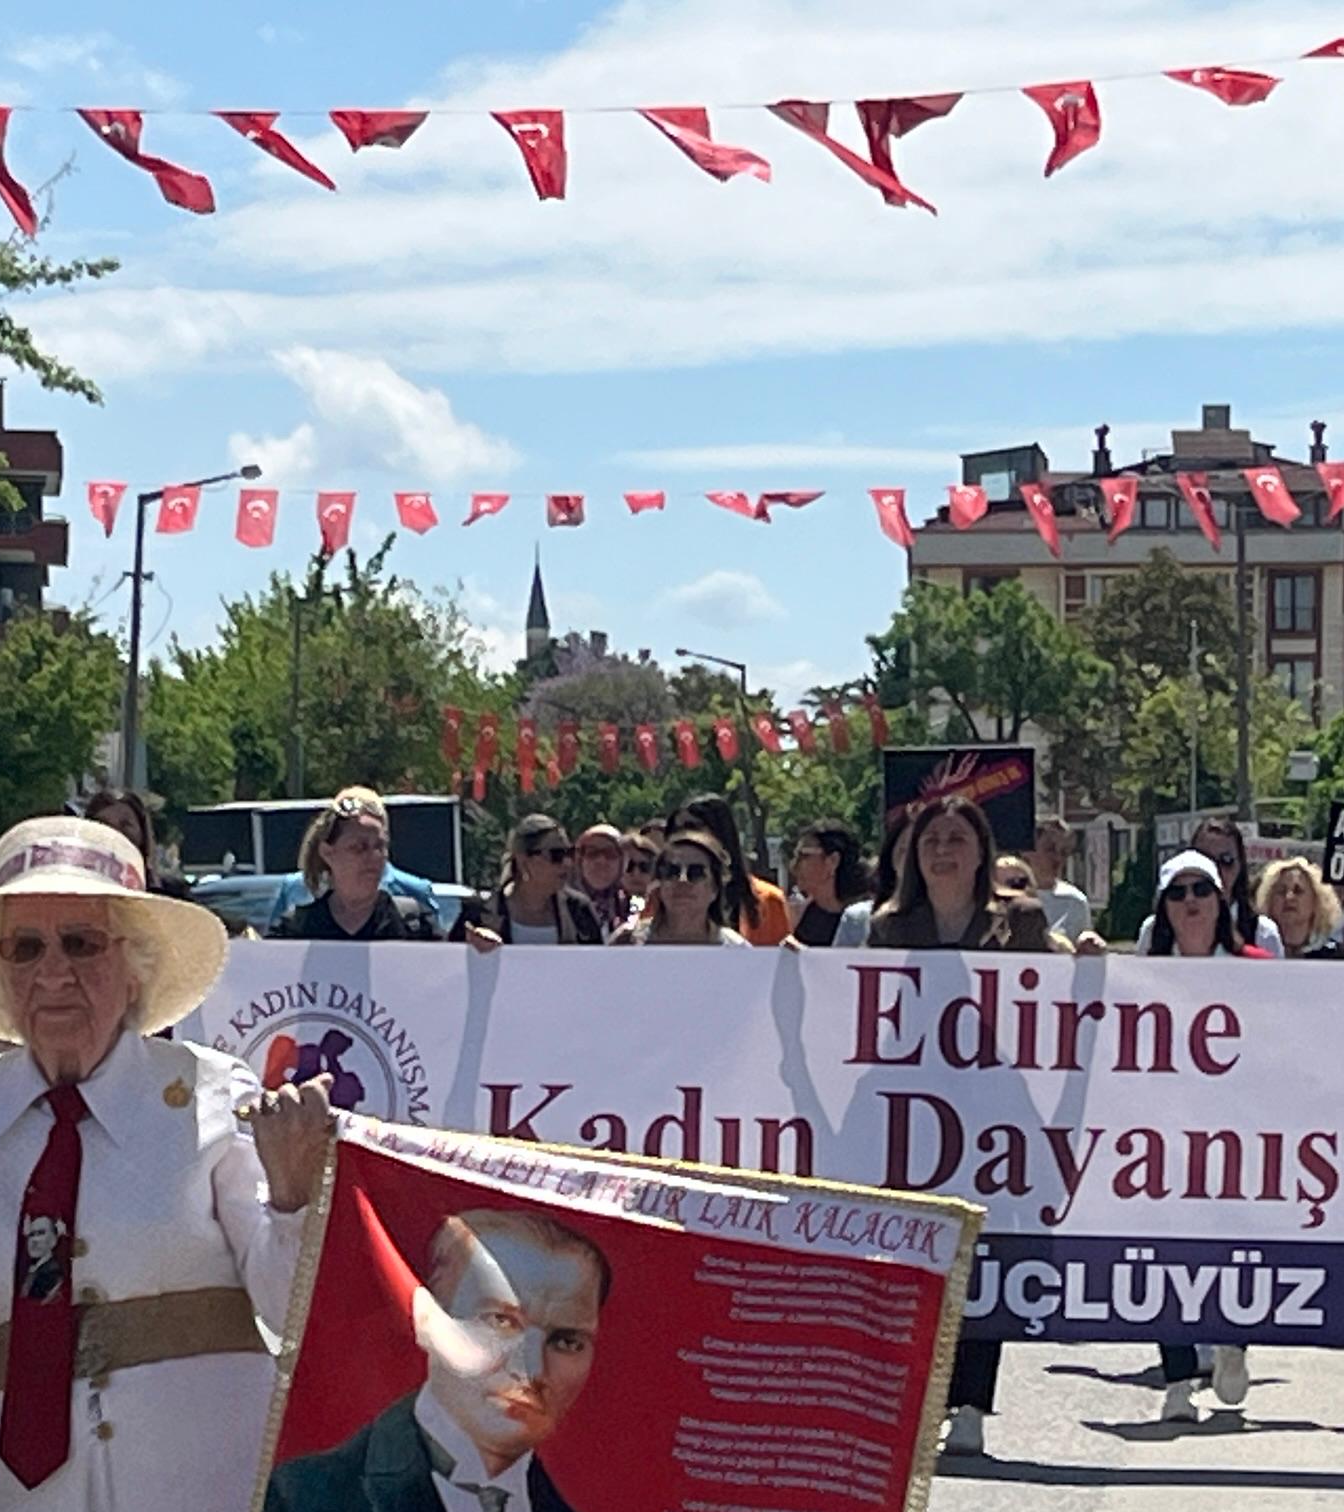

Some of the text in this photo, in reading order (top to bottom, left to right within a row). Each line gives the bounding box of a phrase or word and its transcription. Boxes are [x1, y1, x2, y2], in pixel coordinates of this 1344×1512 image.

[229, 981, 320, 1039] KADIN
[843, 964, 1241, 1076] Edirne
[480, 1083, 814, 1178] Kadın
[793, 1201, 946, 1263] KALACAK
[962, 1243, 1327, 1336] ÜÇLÜYÜZ
